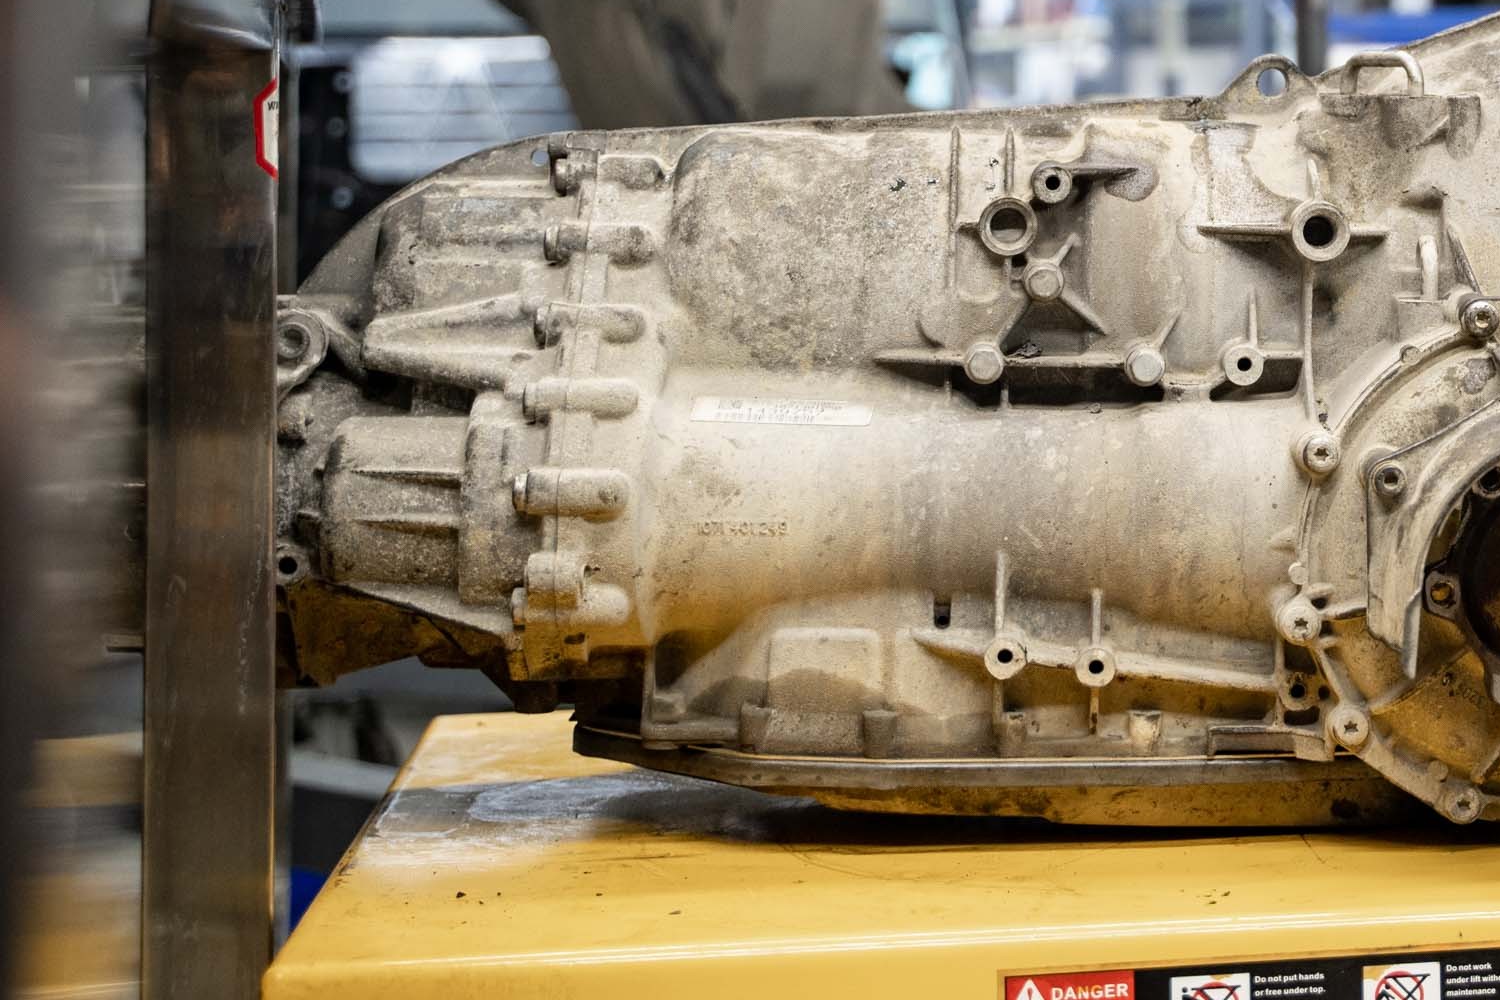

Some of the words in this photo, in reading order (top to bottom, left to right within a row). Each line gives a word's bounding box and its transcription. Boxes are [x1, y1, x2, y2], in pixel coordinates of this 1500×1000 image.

[1446, 964, 1458, 972] Do
[1458, 963, 1472, 971] not
[1472, 962, 1492, 970] work
[1254, 975, 1267, 984] Do
[1267, 974, 1282, 982] not
[1283, 974, 1298, 983] put
[1298, 972, 1325, 980] hands
[1446, 976, 1469, 984] under
[1470, 975, 1481, 983] lift
[1051, 983, 1129, 1000] DANGER
[1254, 989, 1264, 997] or
[1283, 986, 1308, 995] under
[1309, 985, 1326, 995] top.
[1446, 987, 1496, 997] maintenance
